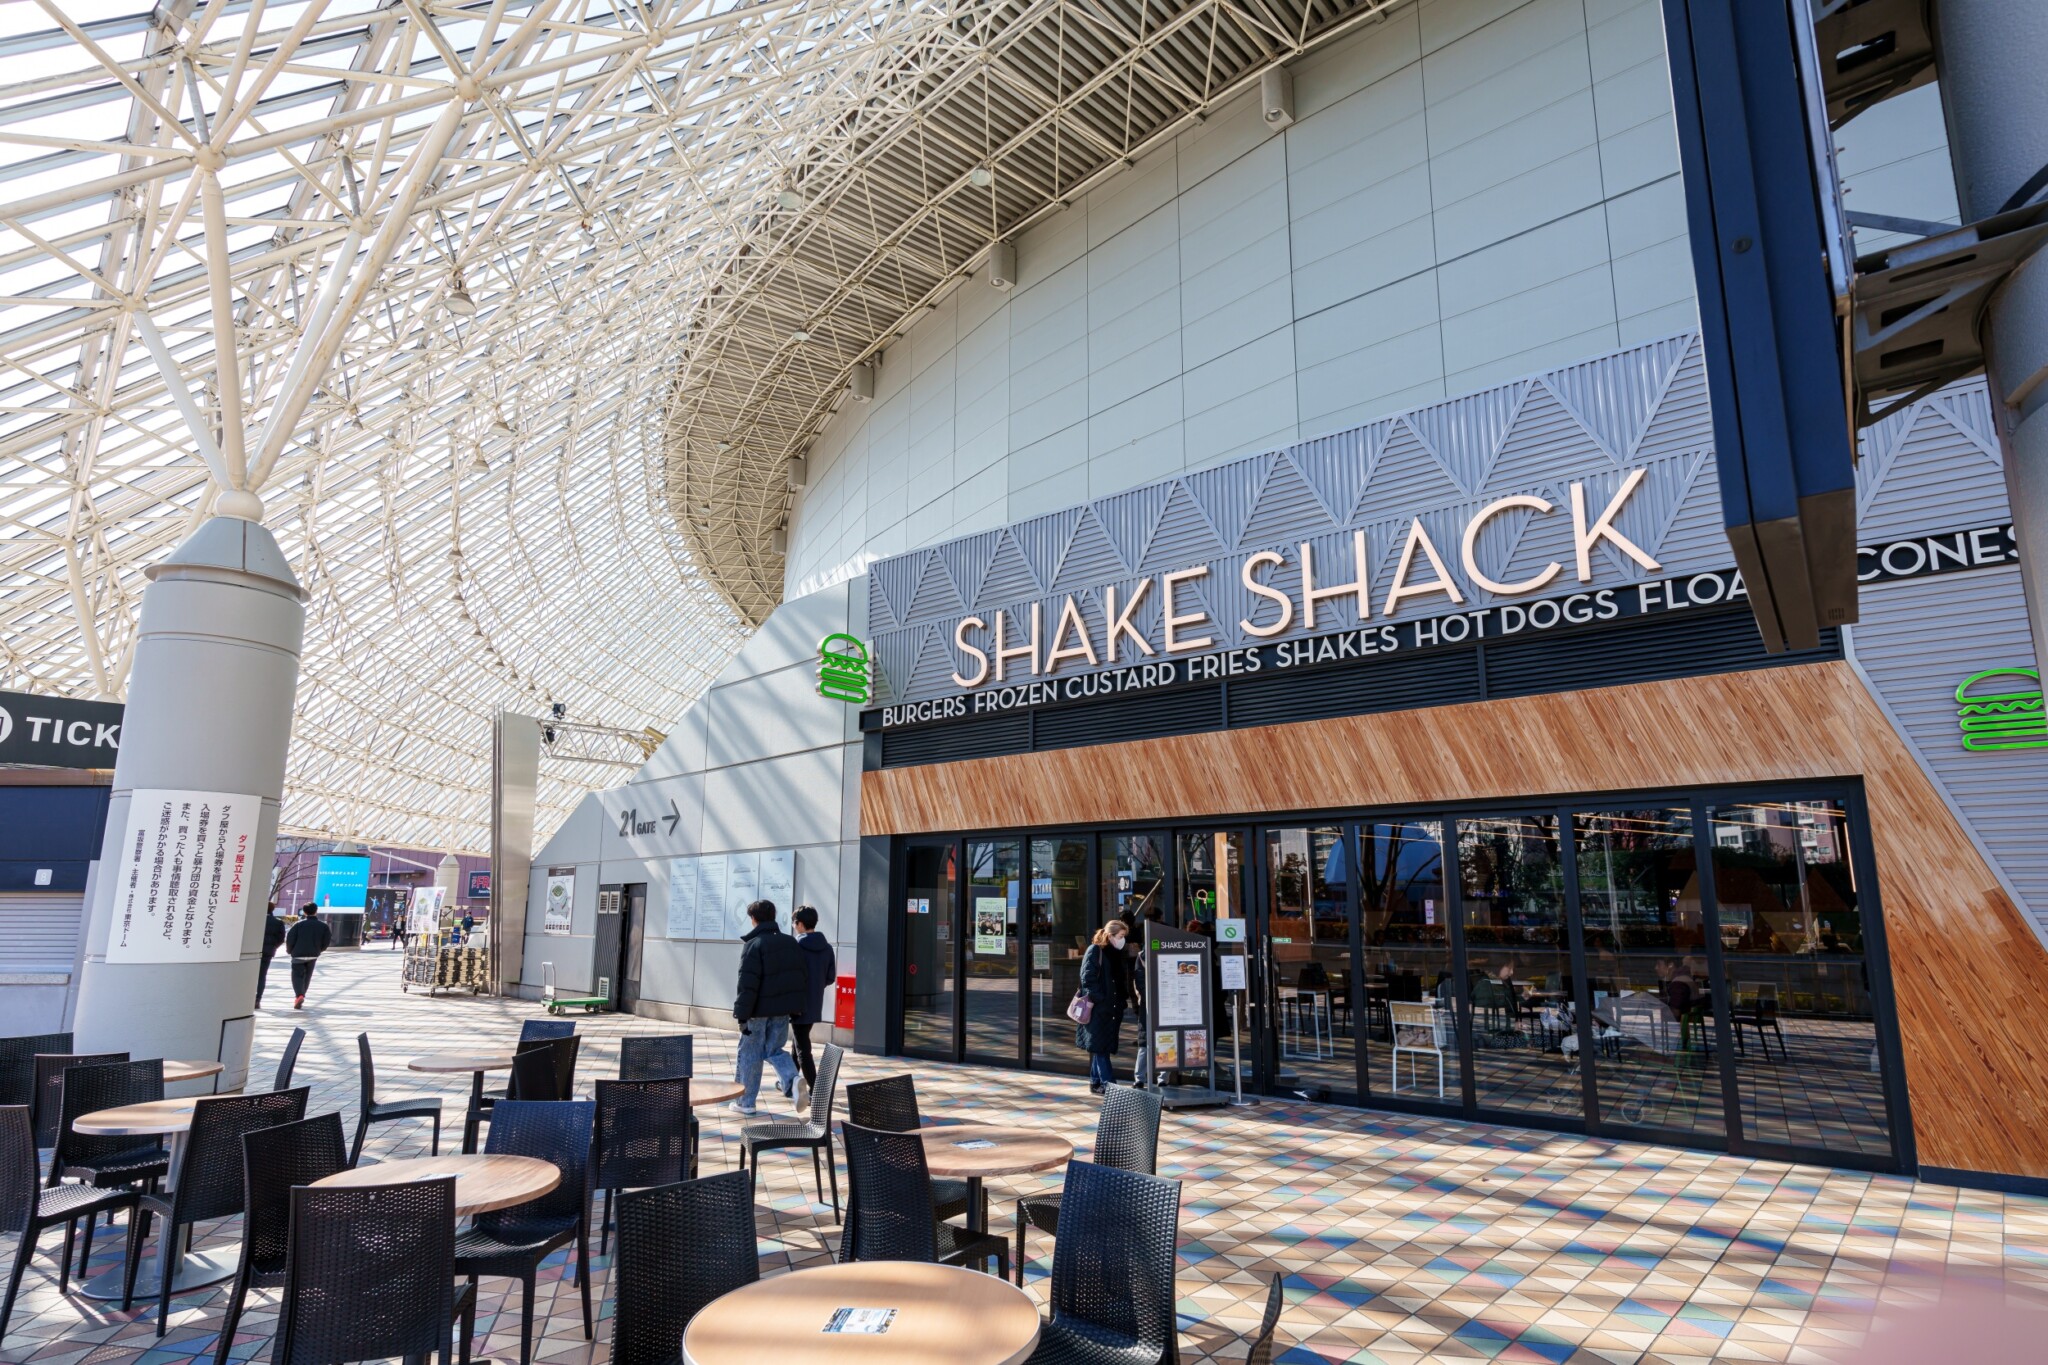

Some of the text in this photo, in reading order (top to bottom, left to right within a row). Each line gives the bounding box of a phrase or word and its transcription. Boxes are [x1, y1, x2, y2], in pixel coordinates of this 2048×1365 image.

[952, 468, 1662, 687] SHAKE SHACK
[882, 695, 967, 727] BURGERS
[975, 680, 1058, 713] FROZEN
[1065, 662, 1176, 699] CUSTARD
[1188, 647, 1262, 681] FRIES
[1276, 625, 1399, 668] SHAKES
[1414, 609, 1491, 647] HOT
[1500, 589, 1619, 635] DOGS
[147, 801, 172, 917] ご迷惑がかかる場合があります。
[181, 803, 211, 949] 入場券を買うと暴力団の資金となります。
[202, 805, 231, 949] ダフ屋から入場券を買わないでください。
[229, 834, 248, 903] ダフ屋立入禁止
[619, 808, 657, 837] 21 GATE
[1160, 941, 1207, 949] SHAKE SHACK
